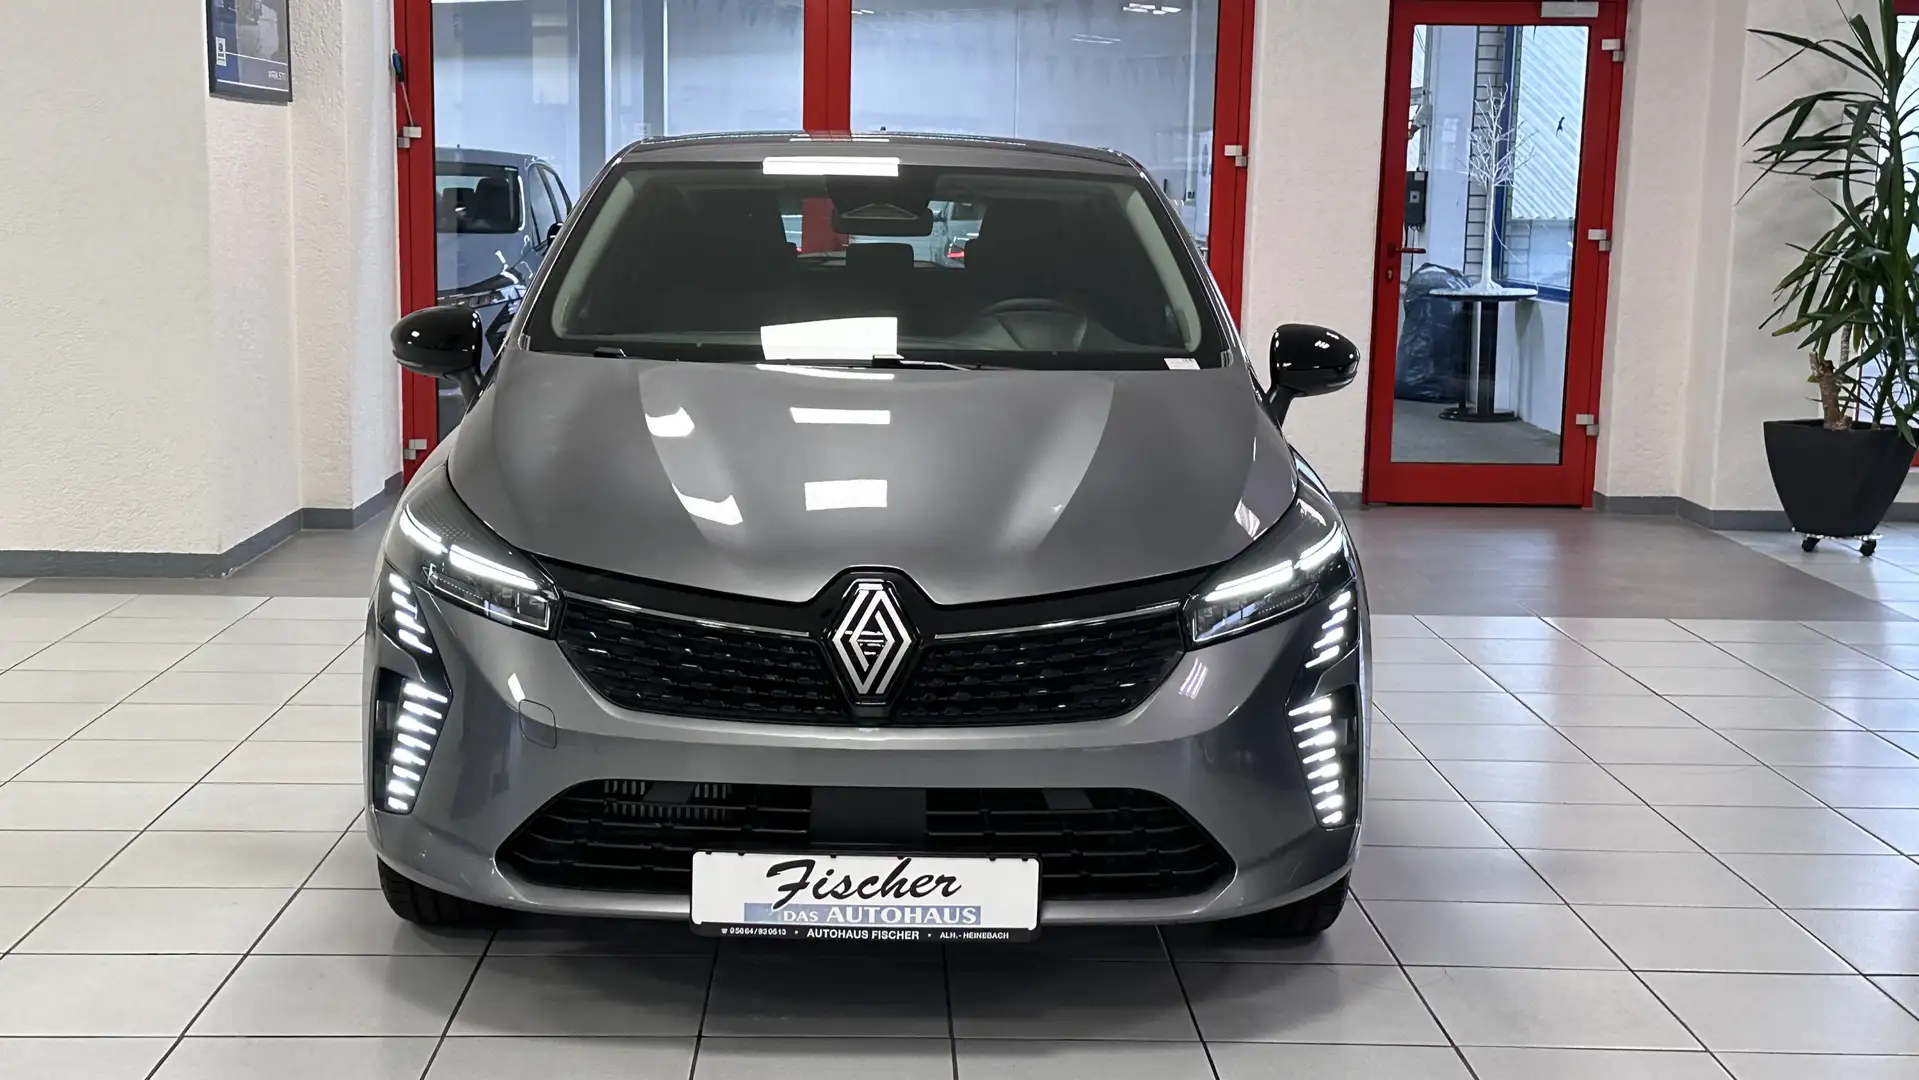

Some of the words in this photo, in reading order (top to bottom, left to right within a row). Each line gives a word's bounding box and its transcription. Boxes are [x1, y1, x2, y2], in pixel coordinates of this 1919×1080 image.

[766, 857, 962, 910] Fischer
[783, 910, 819, 922] DAS
[826, 906, 978, 924] AUTOHAUS
[806, 928, 869, 939] AUTOHAUS
[871, 930, 919, 940] FISCHER
